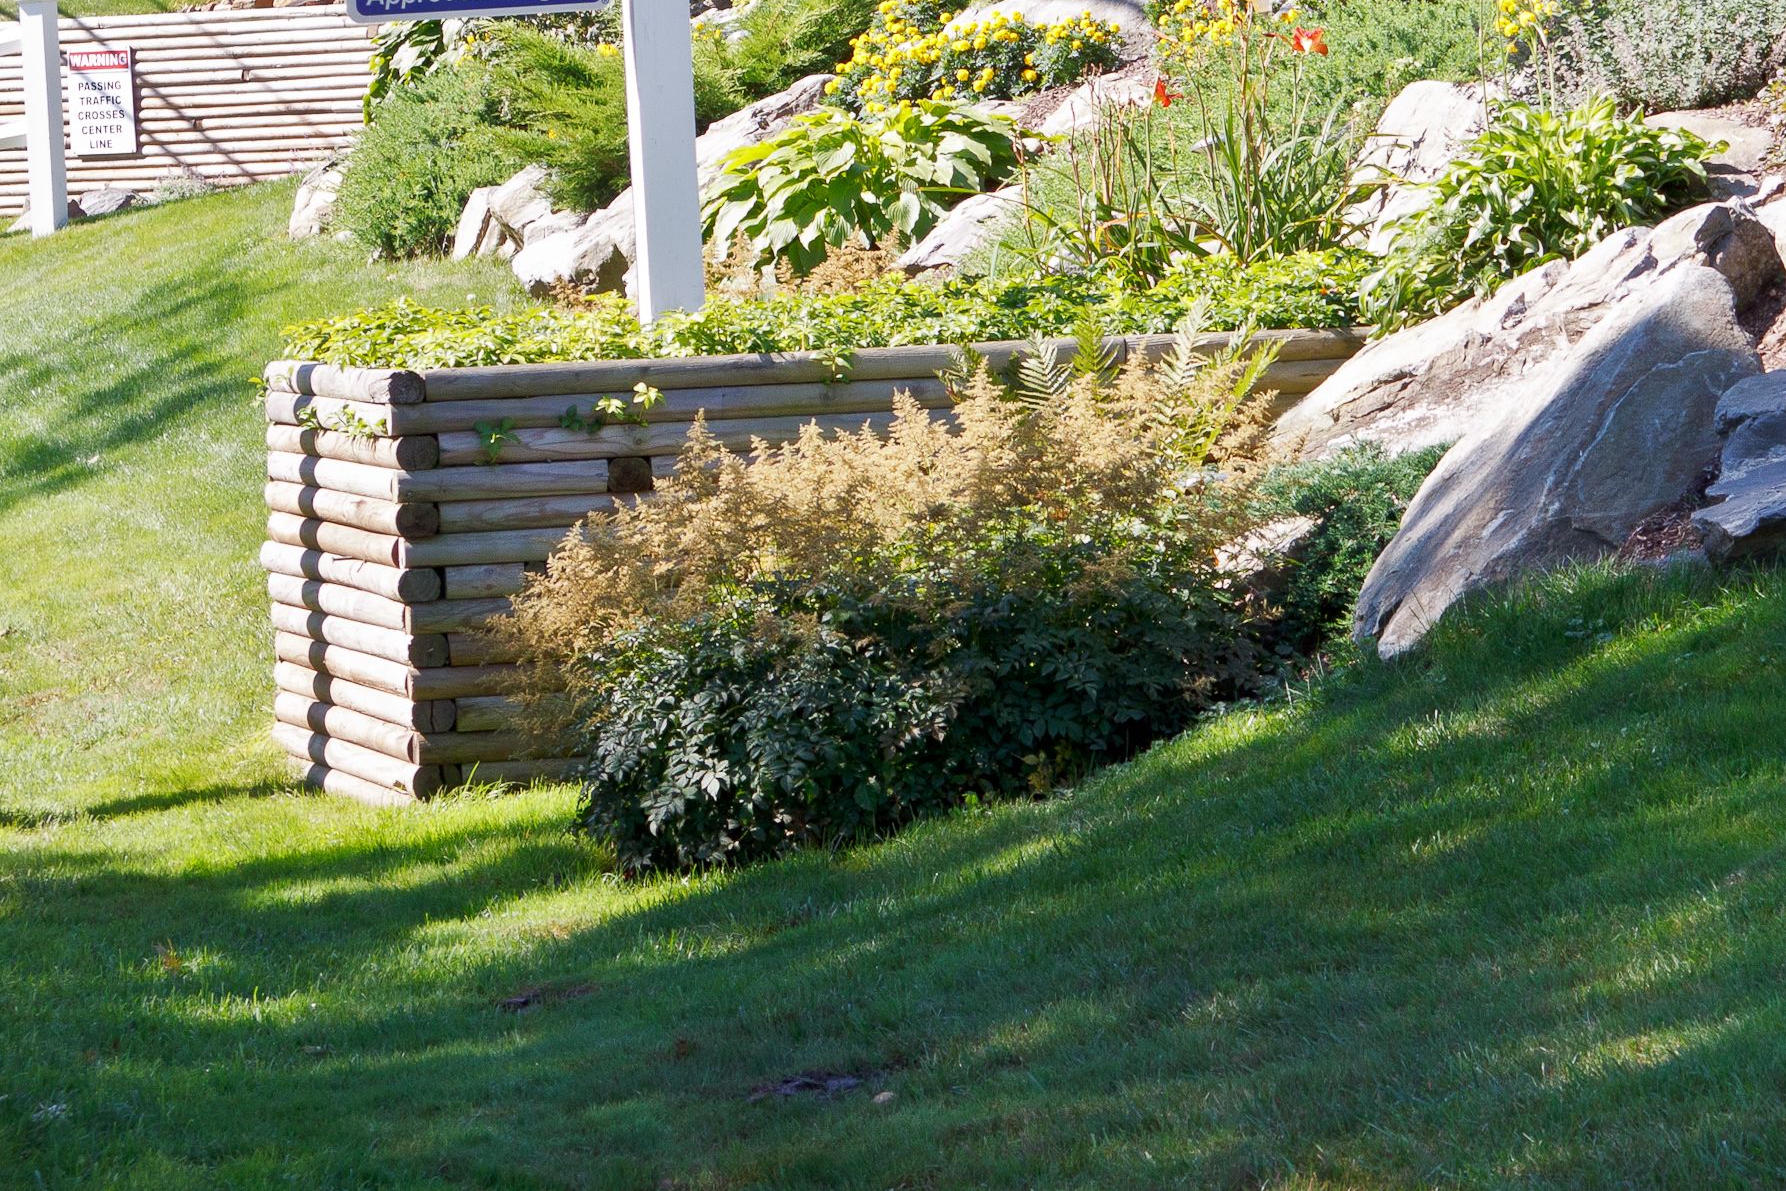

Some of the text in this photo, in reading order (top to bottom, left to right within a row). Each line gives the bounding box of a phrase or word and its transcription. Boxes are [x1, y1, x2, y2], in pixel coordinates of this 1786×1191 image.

[69, 52, 127, 67] WARNING
[78, 81, 122, 91] PASSING
[80, 95, 122, 106] TRAFFIC
[78, 110, 125, 121] CROSSES
[81, 124, 122, 135] CENTER
[90, 139, 113, 149] LINE
